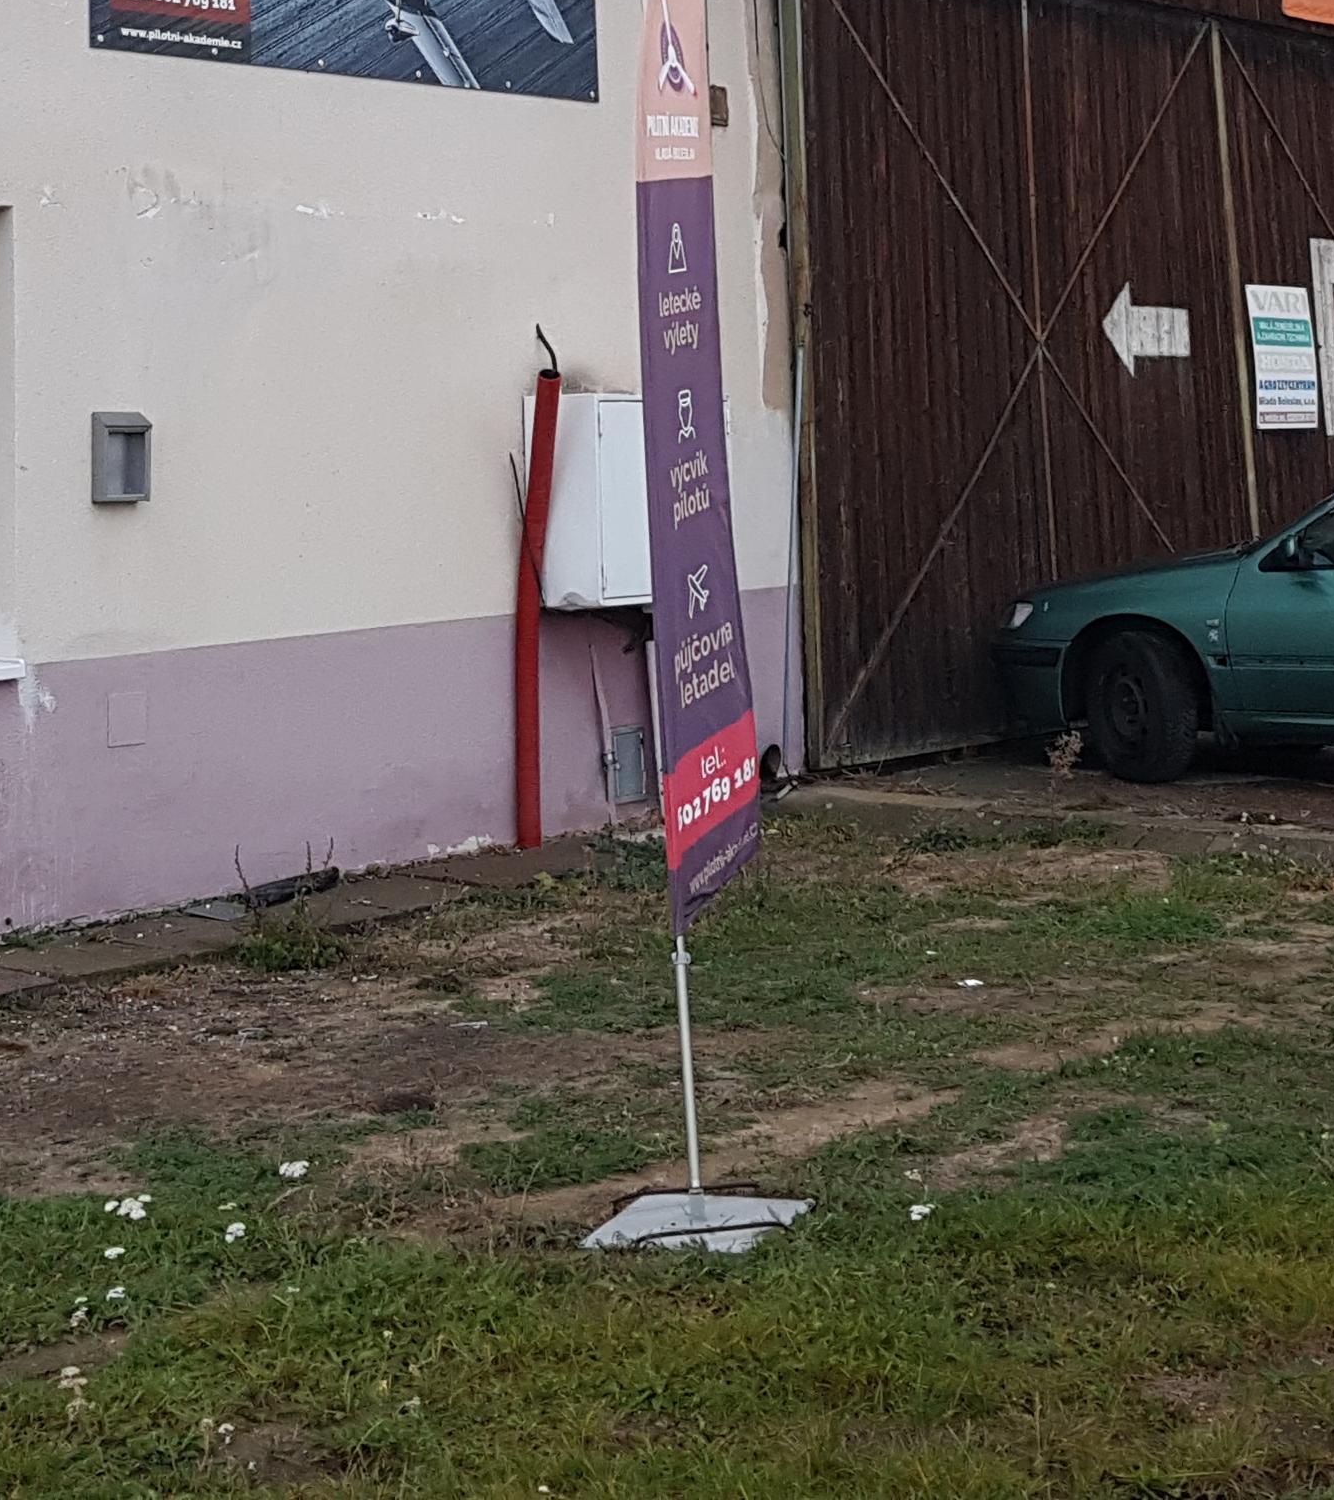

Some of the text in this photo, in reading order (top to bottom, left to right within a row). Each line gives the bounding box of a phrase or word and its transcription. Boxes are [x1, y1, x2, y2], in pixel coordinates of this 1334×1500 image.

[121, 27, 242, 49] www.pilotni-akademie.cz
[659, 285, 702, 318] letecké
[663, 320, 699, 355] výlety
[670, 449, 709, 493] výcvik
[680, 651, 735, 709] letadel
[702, 776, 731, 816] 769
